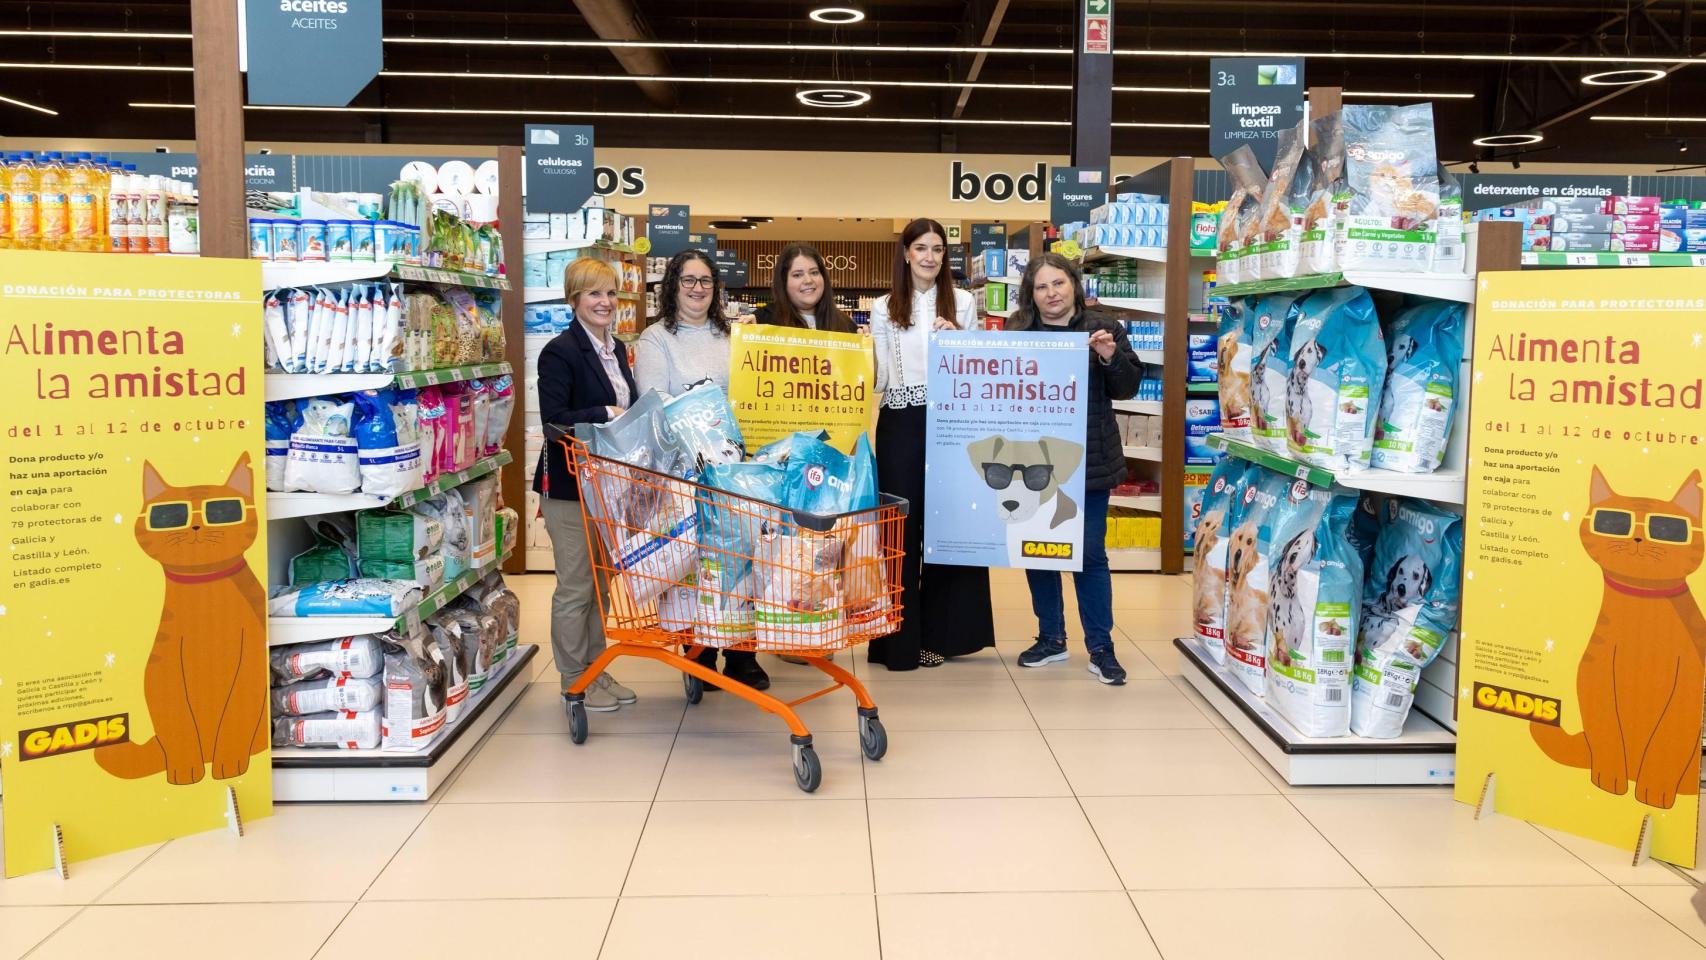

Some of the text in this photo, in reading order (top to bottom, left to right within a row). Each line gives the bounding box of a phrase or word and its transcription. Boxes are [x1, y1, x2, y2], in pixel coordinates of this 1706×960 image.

[280, 0, 348, 14] aceites
[292, 18, 338, 30] ACEITES
[1217, 71, 1236, 86] 3a
[1231, 103, 1281, 117] limpeza
[1240, 115, 1274, 127] textil
[574, 134, 589, 146] 3b
[1224, 130, 1280, 139] LIMPIEZA TEXT
[537, 157, 583, 167] celulosas
[543, 167, 577, 175] CELULOSAS
[1054, 173, 1066, 183] 4a
[1062, 192, 1093, 202] iogures
[1473, 183, 1612, 198] deterxente en cápsulas
[3, 285, 241, 300] DONACIÓN PARA PROTECTORAS
[1491, 299, 1704, 309] DONACIÓN PARA PROTECTORAS
[5, 322, 184, 356] Alimenta
[742, 334, 860, 349] DONACIÓN PARA PROTECTORAS
[938, 338, 983, 347] DONACIÓN
[1488, 332, 1640, 365] Alimenta
[741, 350, 832, 375] Alimenta
[937, 354, 1038, 376] Alimenta
[37, 367, 245, 400] la amistad
[757, 376, 865, 401] la amistad
[953, 378, 1076, 401] la amistad
[1509, 372, 1702, 410] la amistad
[739, 402, 758, 411] del
[808, 404, 819, 413] de
[824, 405, 864, 414] octubre
[937, 403, 955, 411] del
[1009, 404, 1022, 412] de
[1029, 405, 1075, 414] octubre
[8, 419, 245, 438] del 1 al 12 de octubre
[1190, 424, 1224, 432] Detergente
[1485, 420, 1699, 445] del 1 al 12 de octubre
[9, 451, 104, 464] Dona producto y/o
[1484, 447, 1558, 460] Dona producto y/o
[9, 467, 108, 480] haz una aportación
[1483, 460, 1497, 468] haz
[1516, 464, 1561, 474] aportación
[809, 470, 821, 482] ifa
[1494, 476, 1511, 484] caja
[1512, 478, 1531, 486] para
[25, 487, 48, 496] caja
[50, 486, 73, 496] para
[1482, 488, 1520, 497] colaborar
[10, 501, 82, 512] colaborar con
[1482, 502, 1553, 516] 79 protectoras de
[11, 514, 102, 529] 79 protectoras de
[1398, 506, 1434, 535] amigo
[1481, 516, 1507, 526] Galicia
[11, 535, 47, 545] Galicia
[1480, 530, 1510, 540] Castilla
[1518, 534, 1540, 543] León.
[12, 551, 51, 561] Castilla
[63, 547, 90, 556] León.
[1024, 542, 1071, 557] GADIS
[1480, 544, 1549, 559] Listado completo
[1491, 555, 1523, 566] gadis.es
[13, 562, 102, 577] Listado completo
[29, 576, 70, 589] gadis.es
[1205, 626, 1221, 639] 18 Kg
[1244, 652, 1262, 667] 18 Kg
[1293, 669, 1312, 682] 18 Kg
[1477, 686, 1559, 721] GADIS
[23, 716, 127, 755] GADIS
